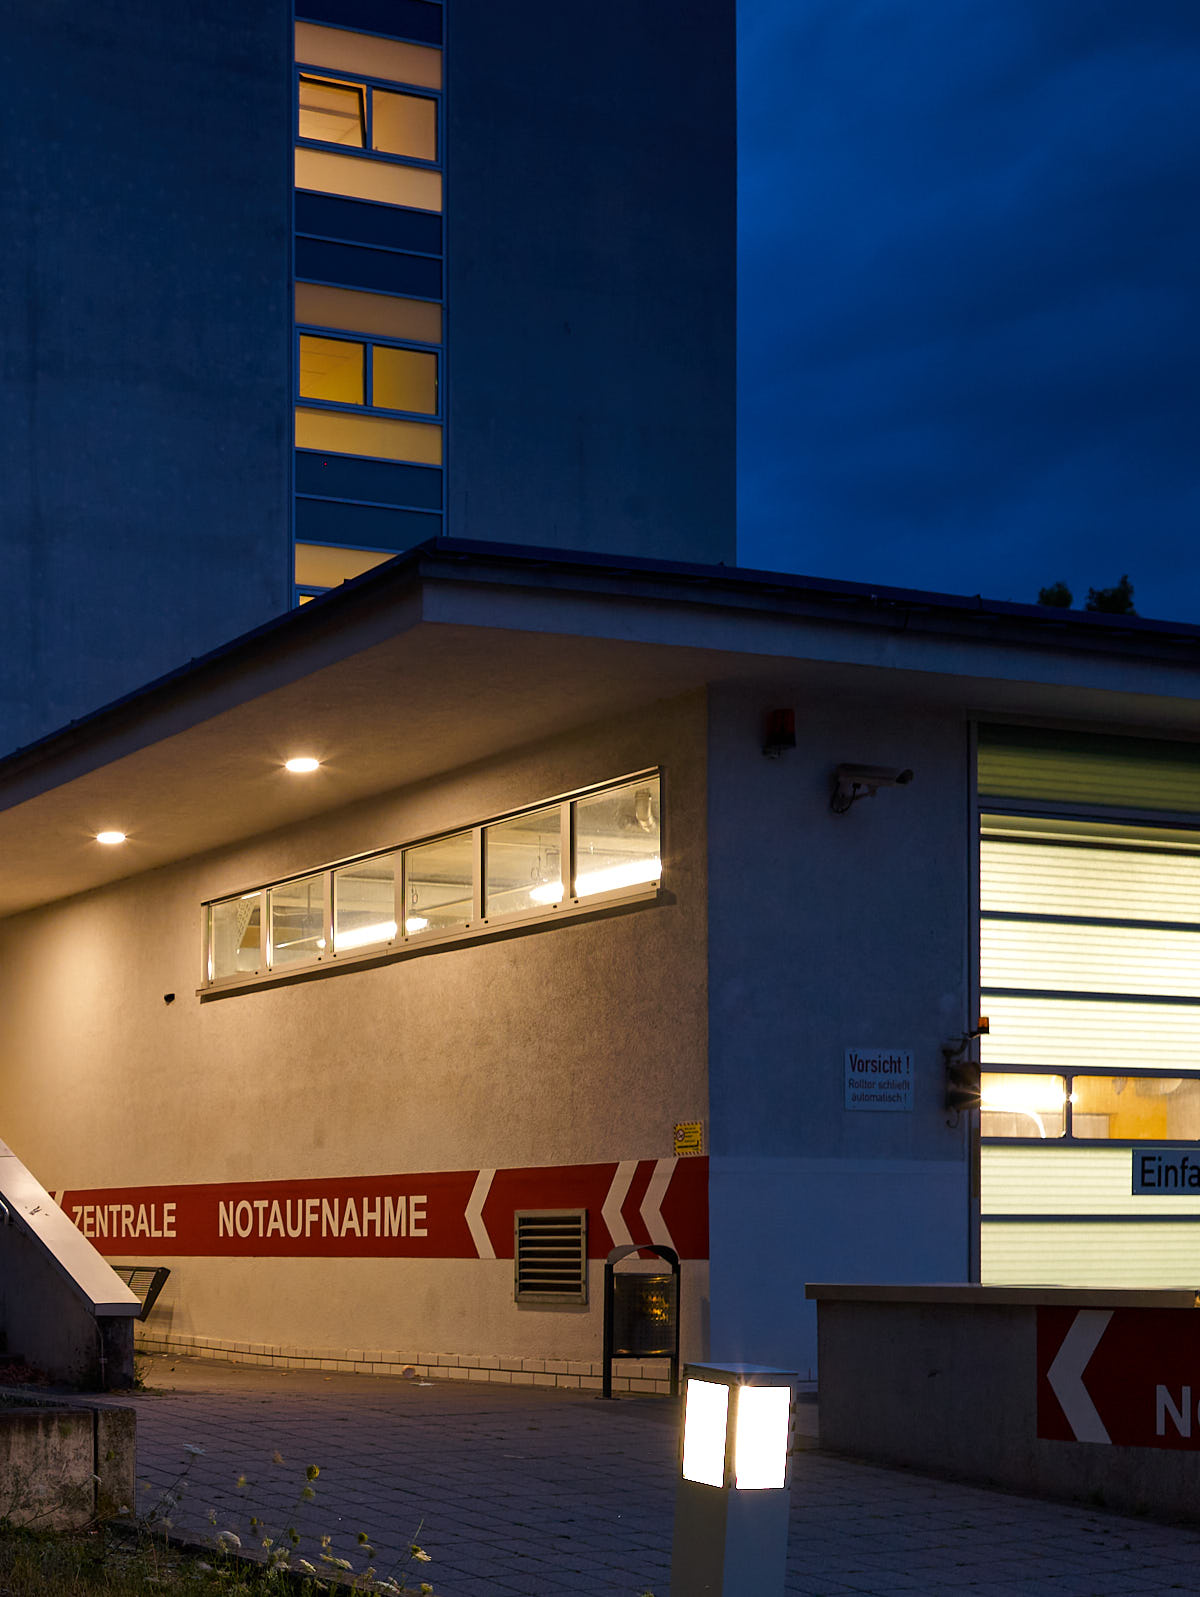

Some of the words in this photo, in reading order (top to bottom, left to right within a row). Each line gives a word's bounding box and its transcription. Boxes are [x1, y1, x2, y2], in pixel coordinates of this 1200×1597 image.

[849, 1053, 902, 1075] Vorsicht
[72, 1202, 177, 1238] ZENTRALE
[218, 1195, 428, 1238] NOTAUFNAHME
[1156, 1384, 1200, 1438] N
